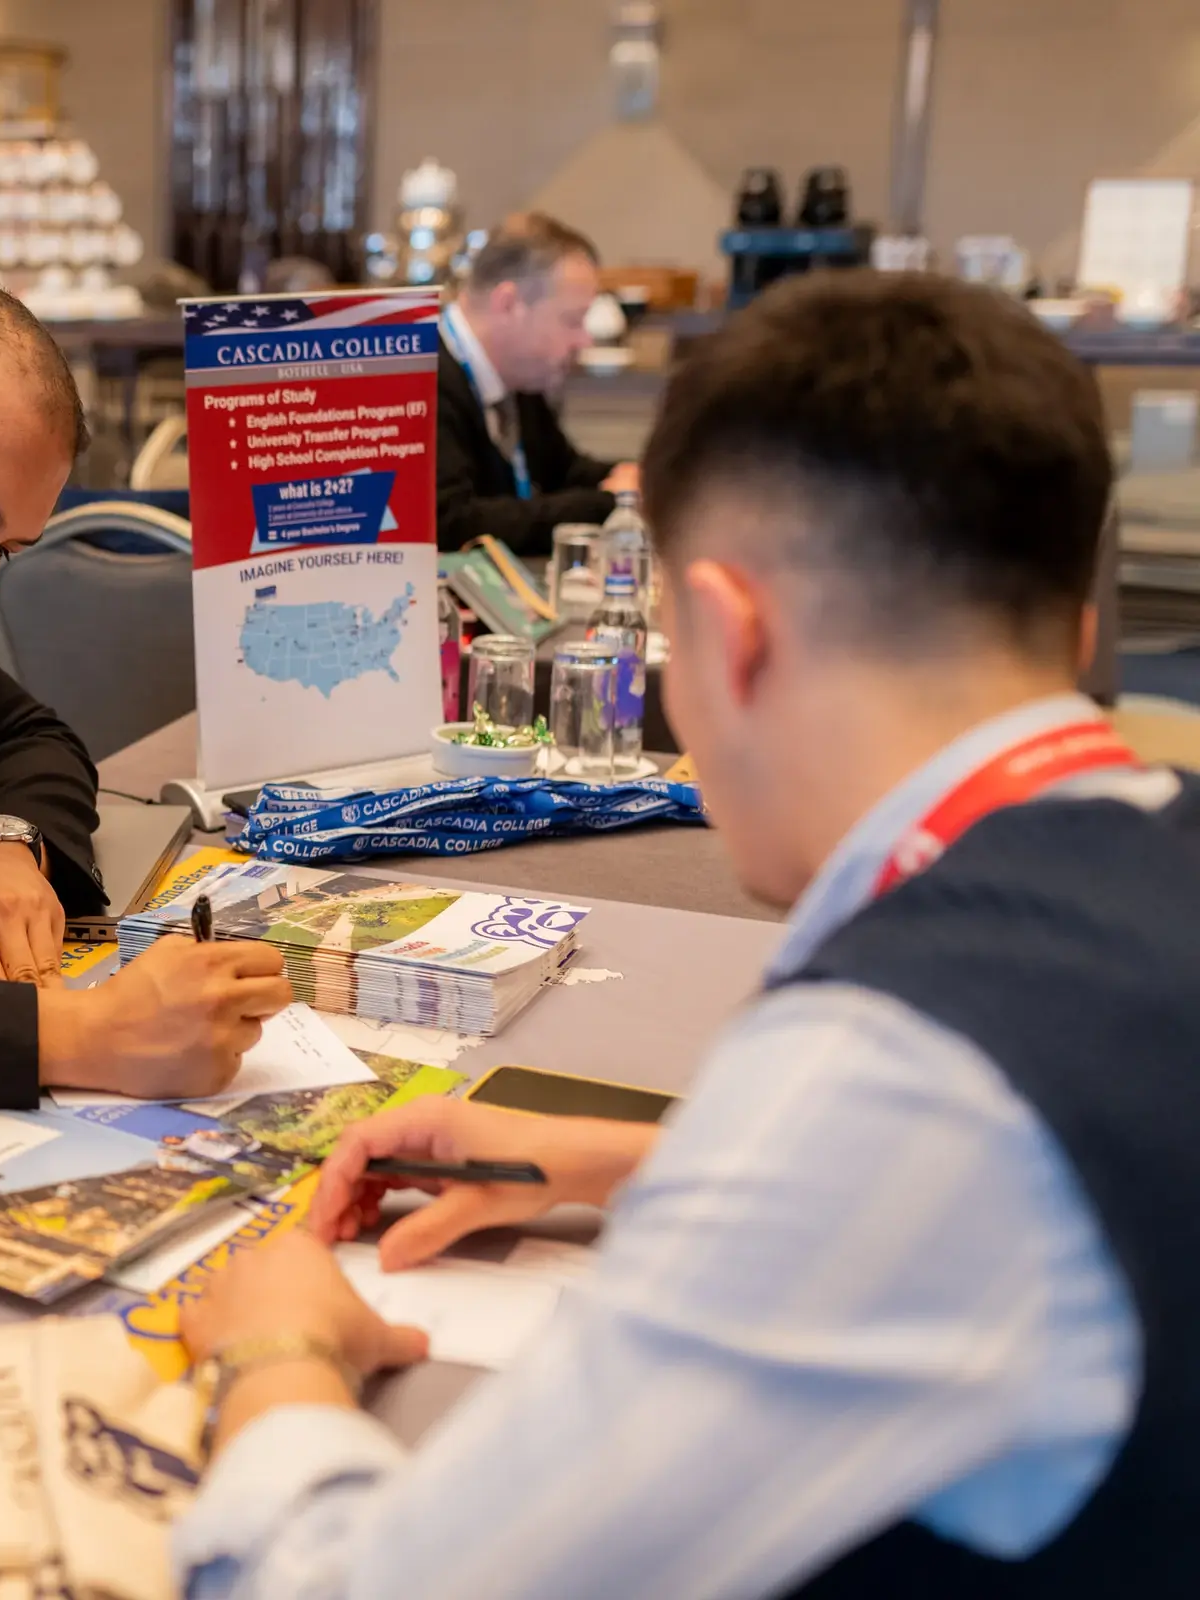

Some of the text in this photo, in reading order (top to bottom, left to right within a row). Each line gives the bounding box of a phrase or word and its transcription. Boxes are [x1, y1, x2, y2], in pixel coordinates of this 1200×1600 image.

[216, 334, 422, 365] CASCADIA COLLEGE
[277, 362, 364, 379] BOTHELL USA
[203, 387, 317, 411] Programs of Study
[245, 400, 427, 430] English Foundations Program (EF)
[246, 424, 399, 449] University Transfer Program
[247, 441, 425, 472] High School Completion Program
[279, 482, 309, 501] what
[310, 480, 322, 498] is
[239, 550, 405, 583] IMAGINE YOURSELF HERE!
[362, 783, 432, 816] CASCADIA
[415, 816, 488, 832] CASCADIA
[370, 835, 440, 850] CASCADIA
